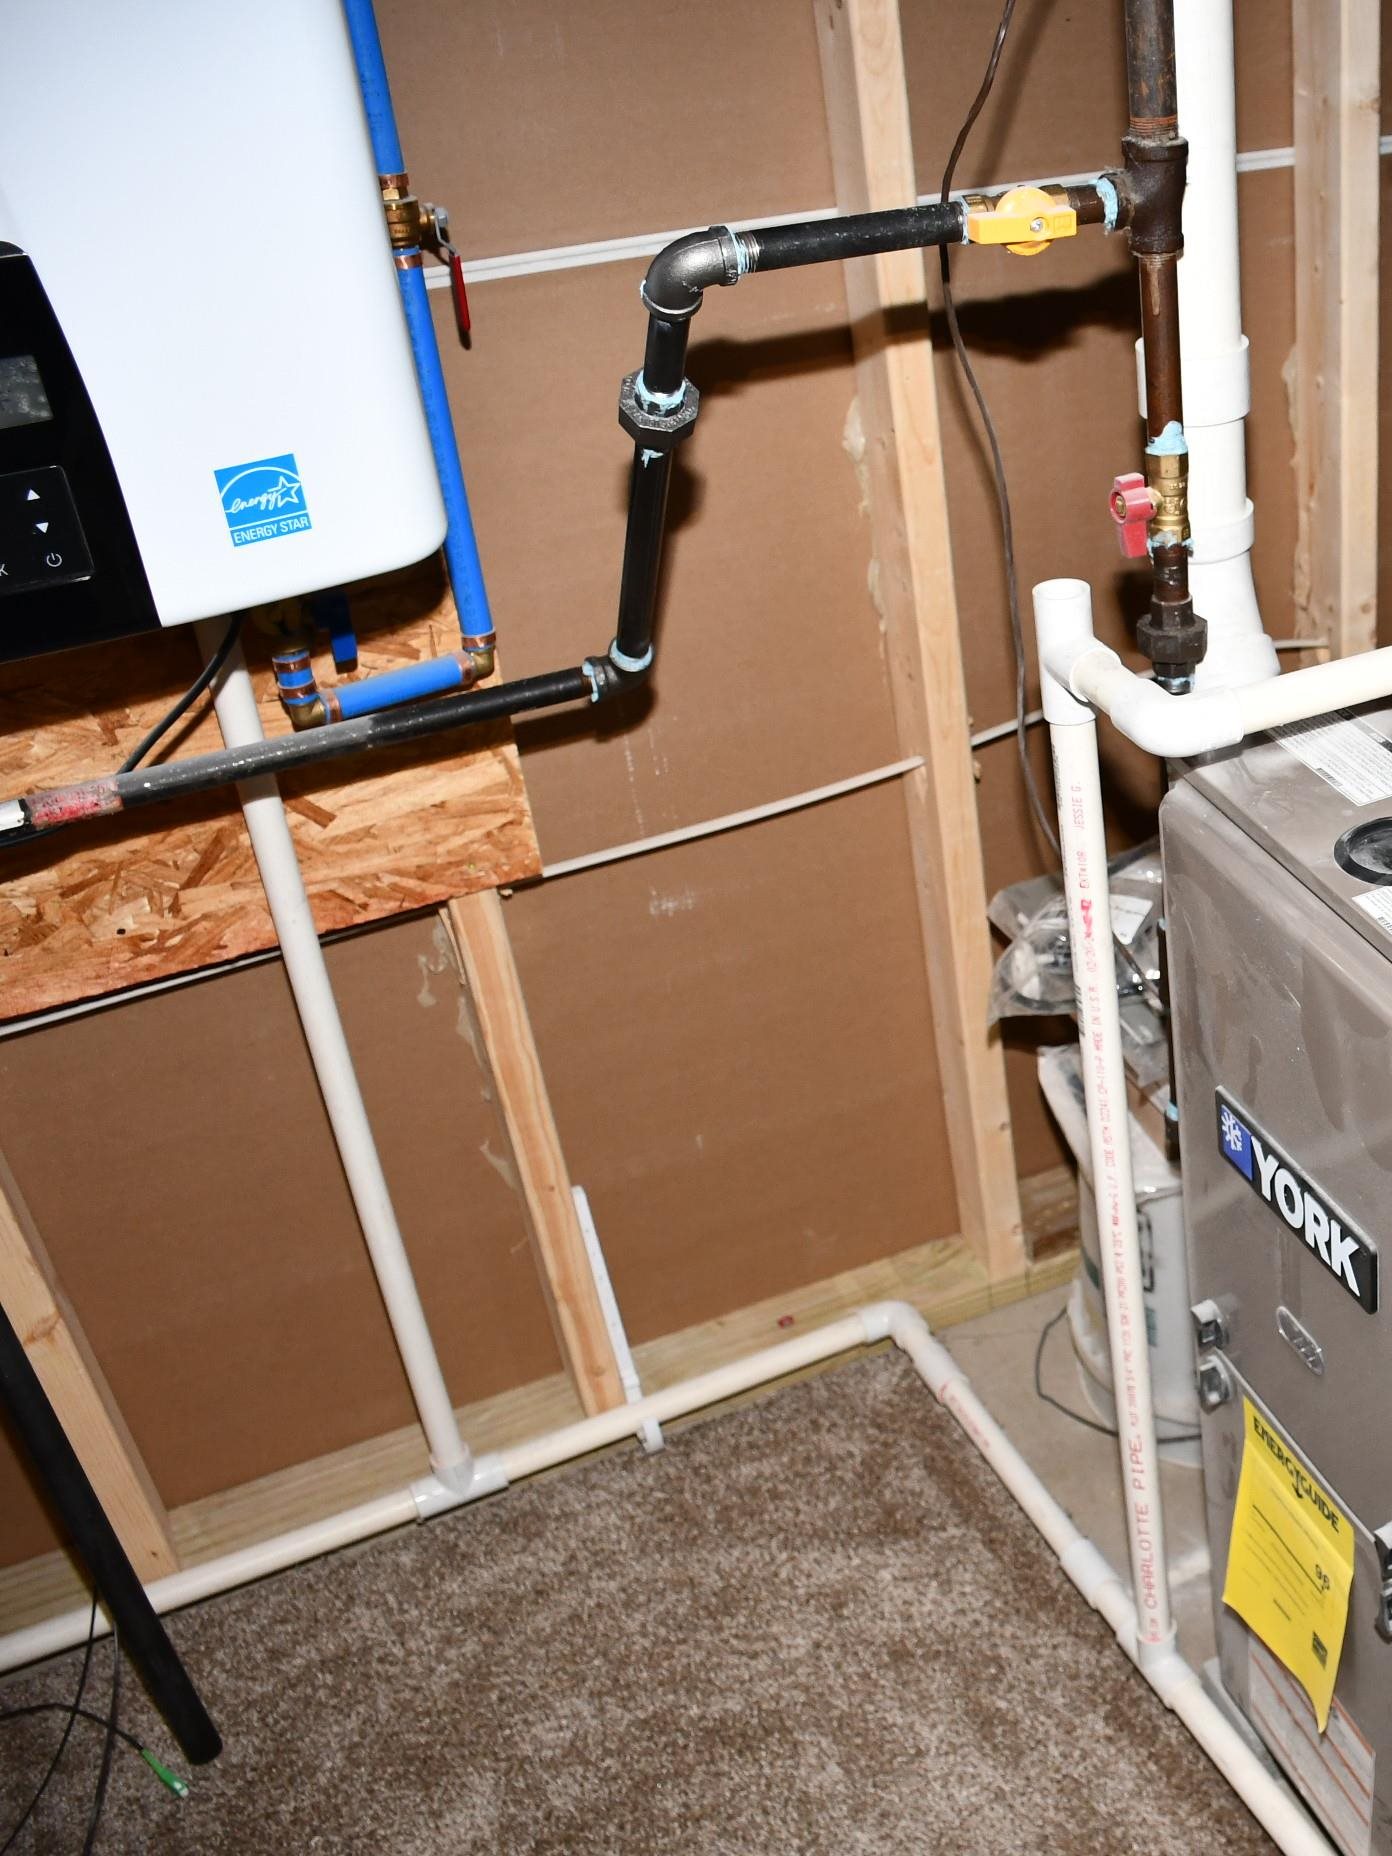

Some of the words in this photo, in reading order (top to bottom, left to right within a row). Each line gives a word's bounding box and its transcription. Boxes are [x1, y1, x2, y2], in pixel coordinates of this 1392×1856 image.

[233, 524, 278, 544] ENERGY
[279, 516, 309, 533] STAR
[1251, 1135, 1361, 1297] YORK
[1136, 1502, 1158, 1610] CHARLOTTE
